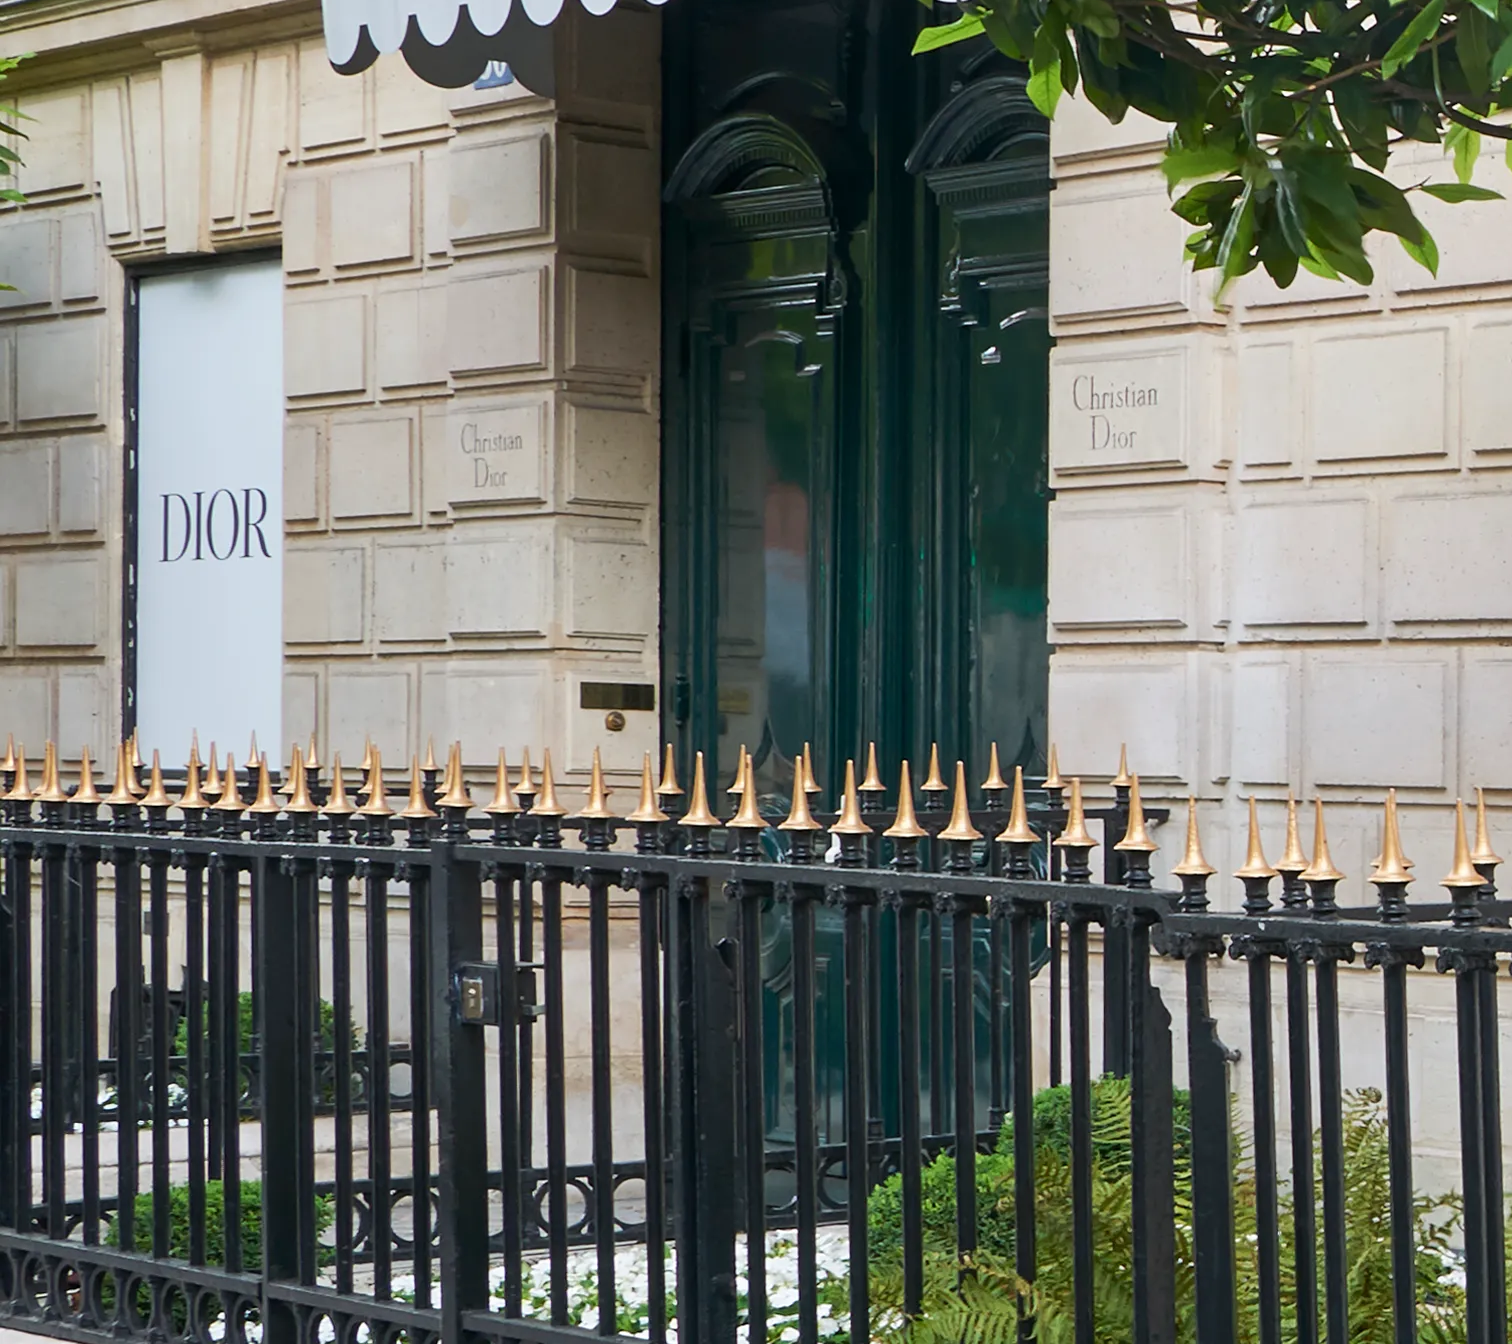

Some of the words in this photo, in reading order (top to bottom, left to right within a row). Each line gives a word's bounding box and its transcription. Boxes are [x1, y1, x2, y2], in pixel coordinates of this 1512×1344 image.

[1072, 374, 1158, 411] Christian
[460, 422, 523, 454] Christian
[1088, 414, 1137, 450] Dior
[473, 457, 508, 488] Dior
[158, 487, 272, 562] DIOR
